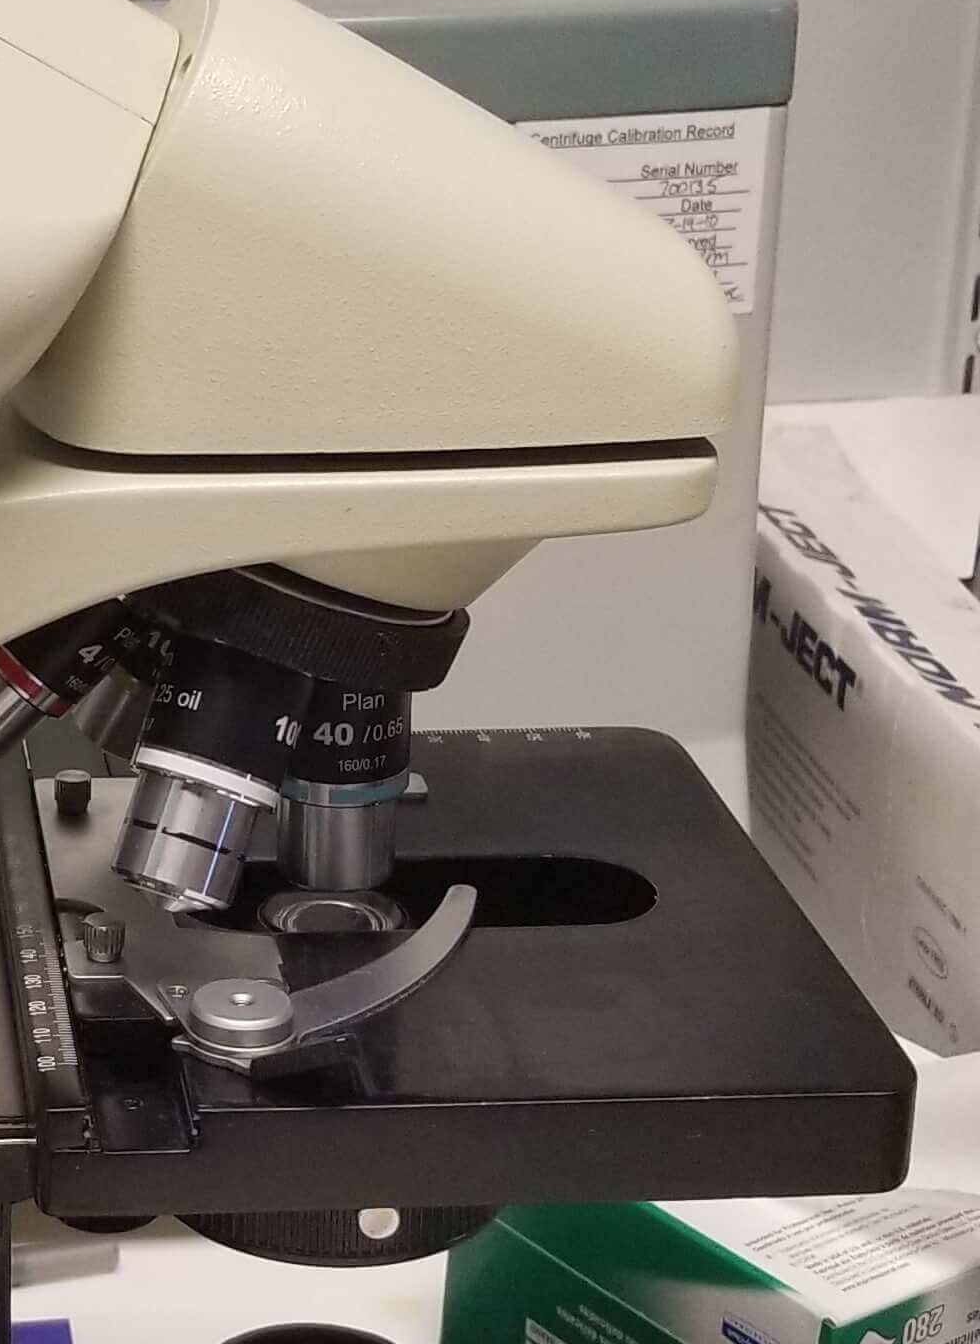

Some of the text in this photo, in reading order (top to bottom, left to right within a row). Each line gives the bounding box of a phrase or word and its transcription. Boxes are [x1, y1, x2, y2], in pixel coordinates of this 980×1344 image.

[607, 125, 684, 145] Calibration
[687, 121, 735, 140] Record
[640, 160, 738, 179] Serial Number
[680, 198, 713, 213] Date
[176, 689, 203, 712] oil
[341, 693, 386, 712] Plan
[312, 722, 355, 747] 40
[23, 974, 42, 991] 130
[28, 1000, 47, 1018] 120
[33, 1027, 52, 1046] 110
[38, 1055, 57, 1074] 100
